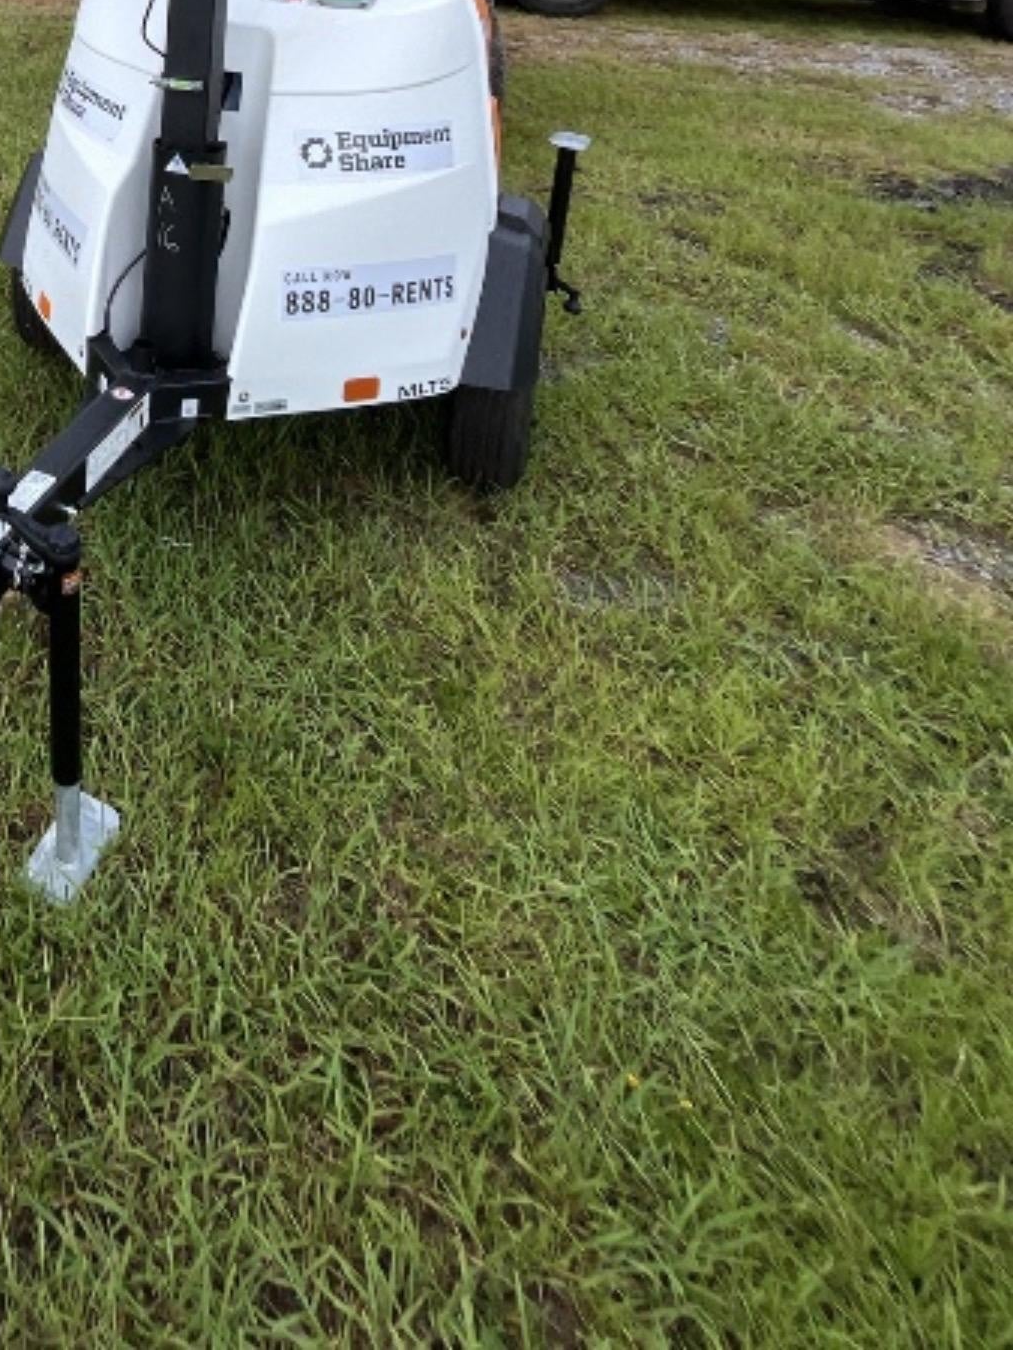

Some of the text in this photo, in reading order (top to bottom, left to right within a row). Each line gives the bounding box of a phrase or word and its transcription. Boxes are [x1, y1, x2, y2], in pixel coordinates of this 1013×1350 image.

[334, 126, 451, 153] Equipment
[338, 152, 406, 172] Share
[284, 271, 319, 285] CALL
